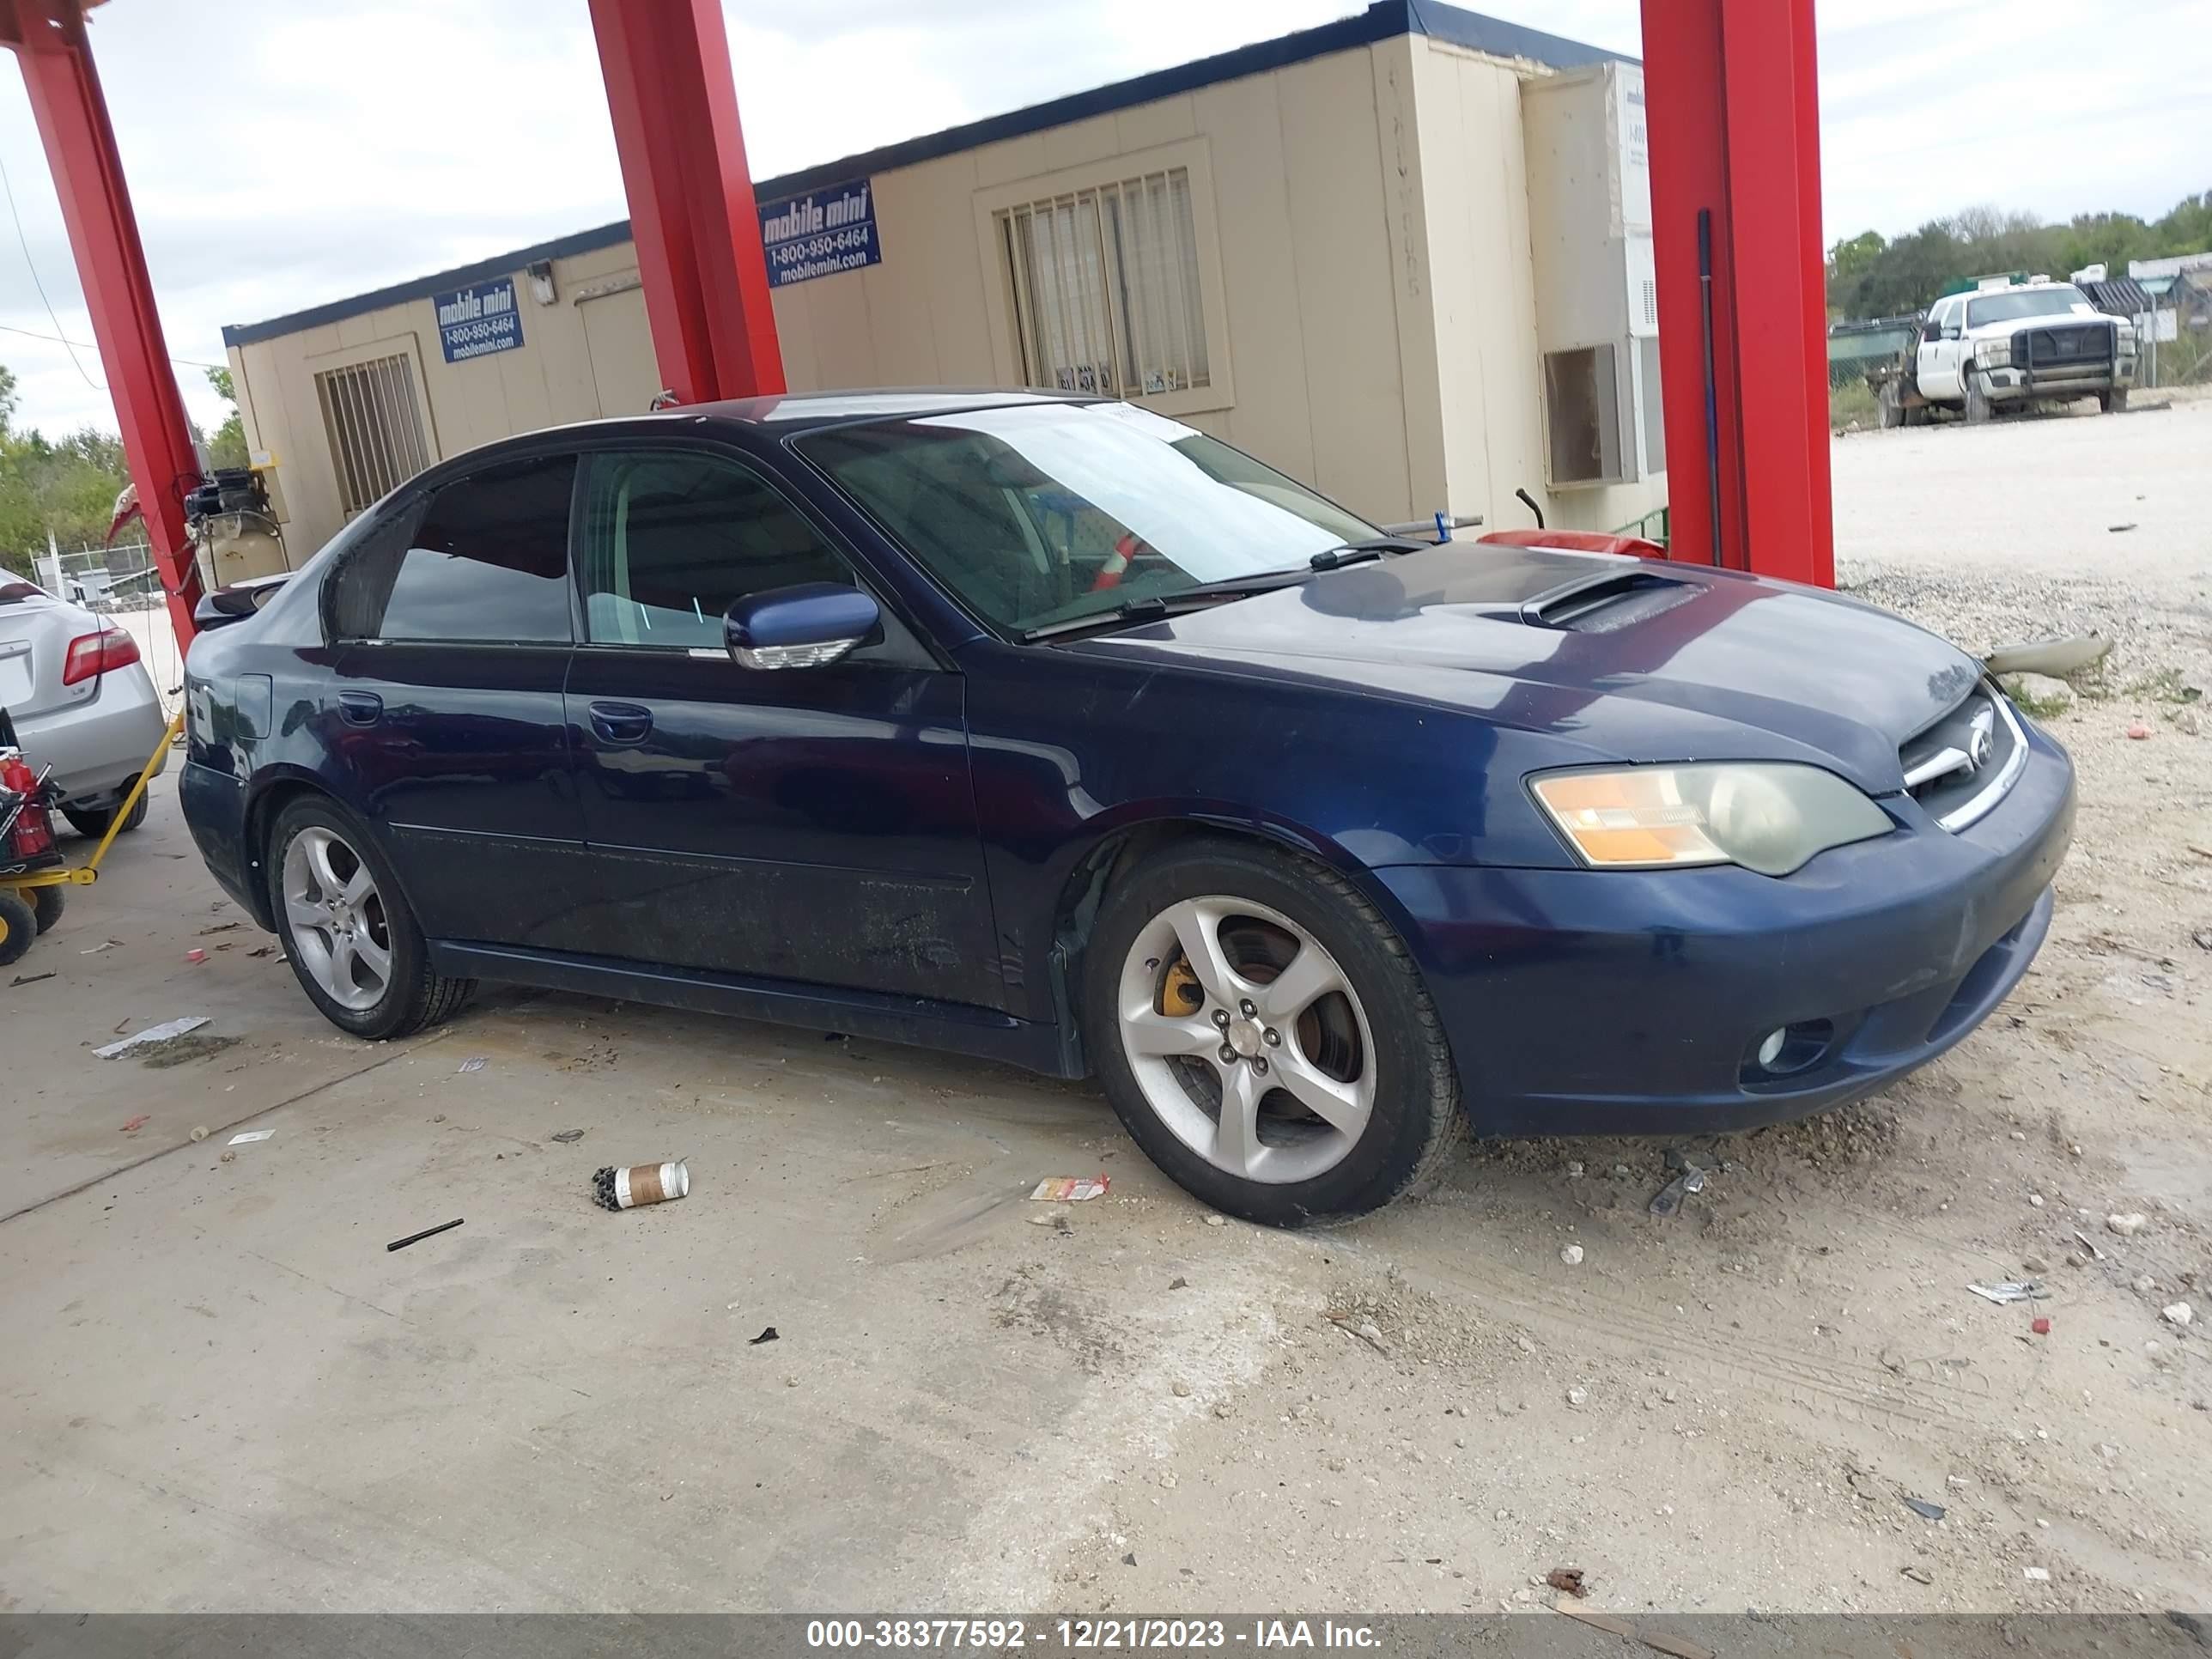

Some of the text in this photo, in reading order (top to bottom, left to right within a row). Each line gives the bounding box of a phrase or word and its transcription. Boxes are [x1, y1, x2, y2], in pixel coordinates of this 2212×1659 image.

[763, 186, 868, 245] mobile mini
[771, 226, 869, 267] 1-800-950-6464
[781, 250, 867, 284] mobilemini.com
[439, 283, 512, 325] mobile mini
[445, 315, 515, 346] 1-800-950-6464
[453, 335, 514, 360] mobilemini.com
